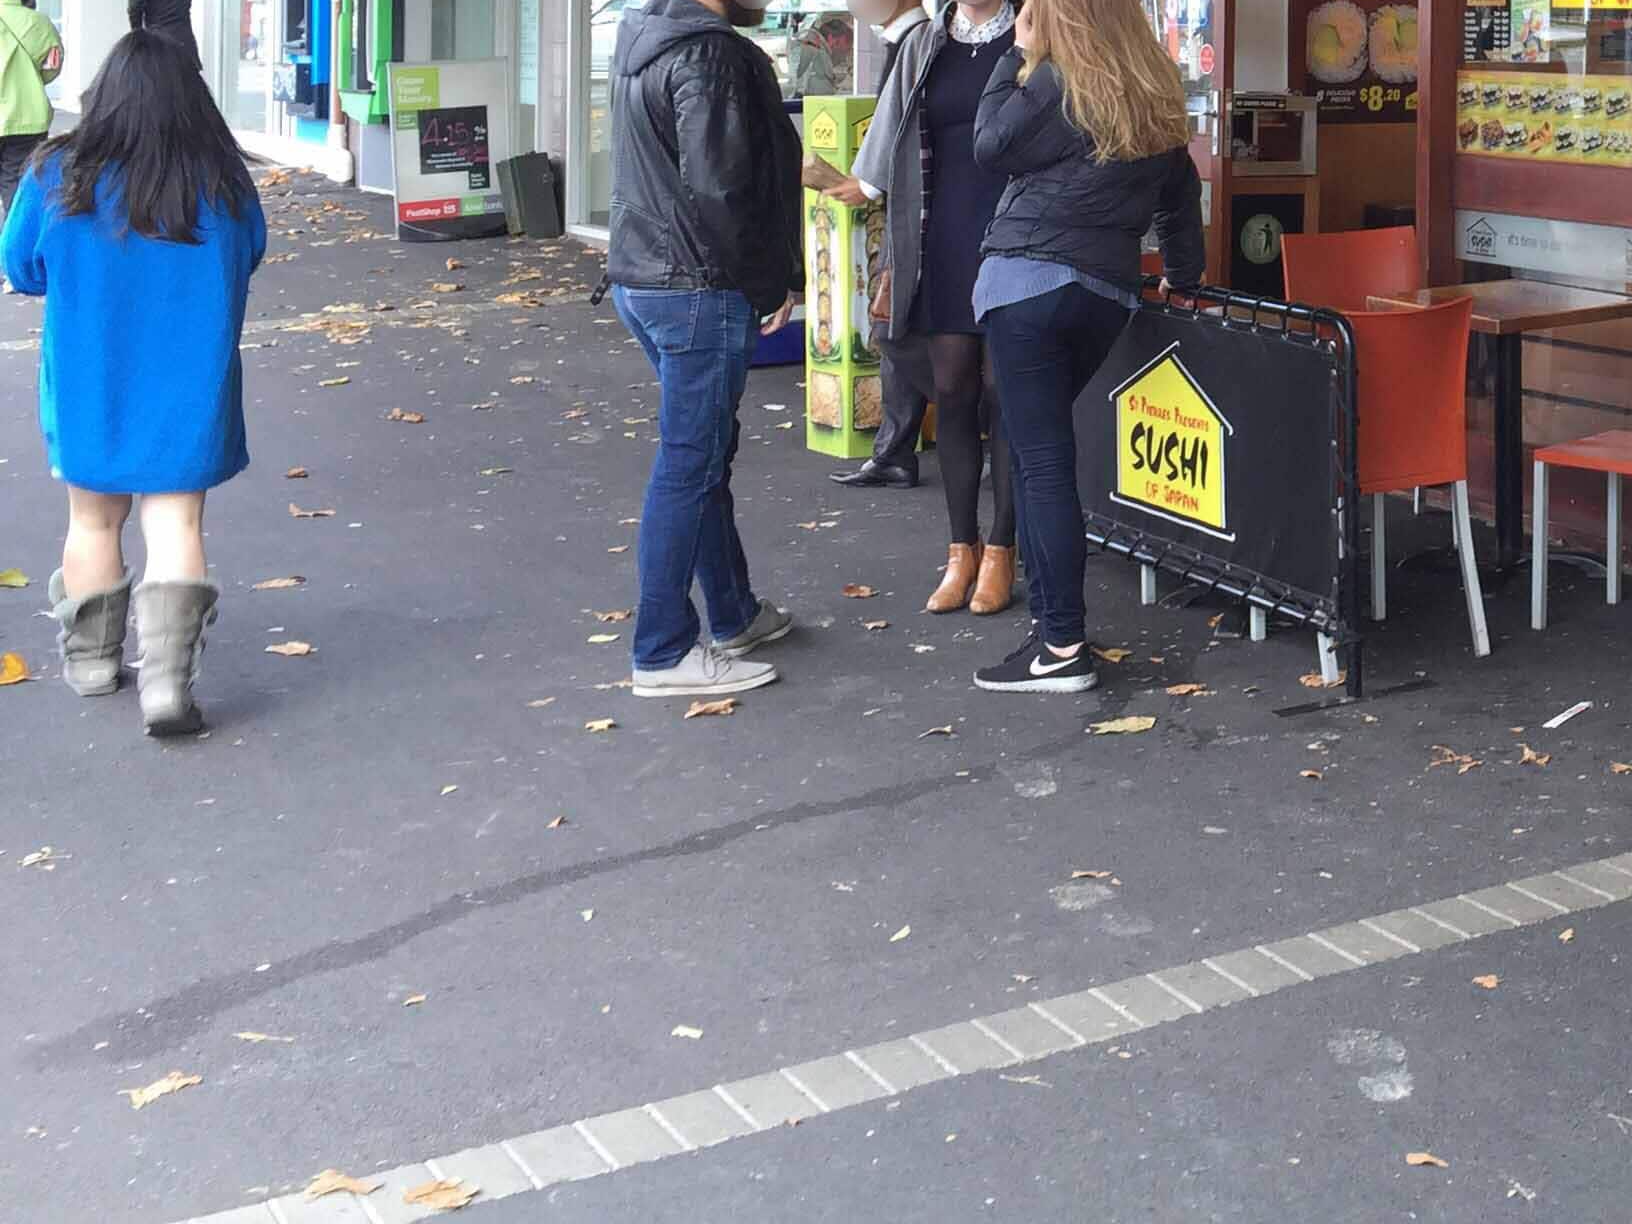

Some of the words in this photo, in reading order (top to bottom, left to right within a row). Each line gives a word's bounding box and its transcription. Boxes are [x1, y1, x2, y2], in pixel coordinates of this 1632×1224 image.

[1360, 85, 1400, 111] $8.20
[1131, 422, 1208, 490] SUSHI
[1164, 484, 1199, 512] JAPAN
